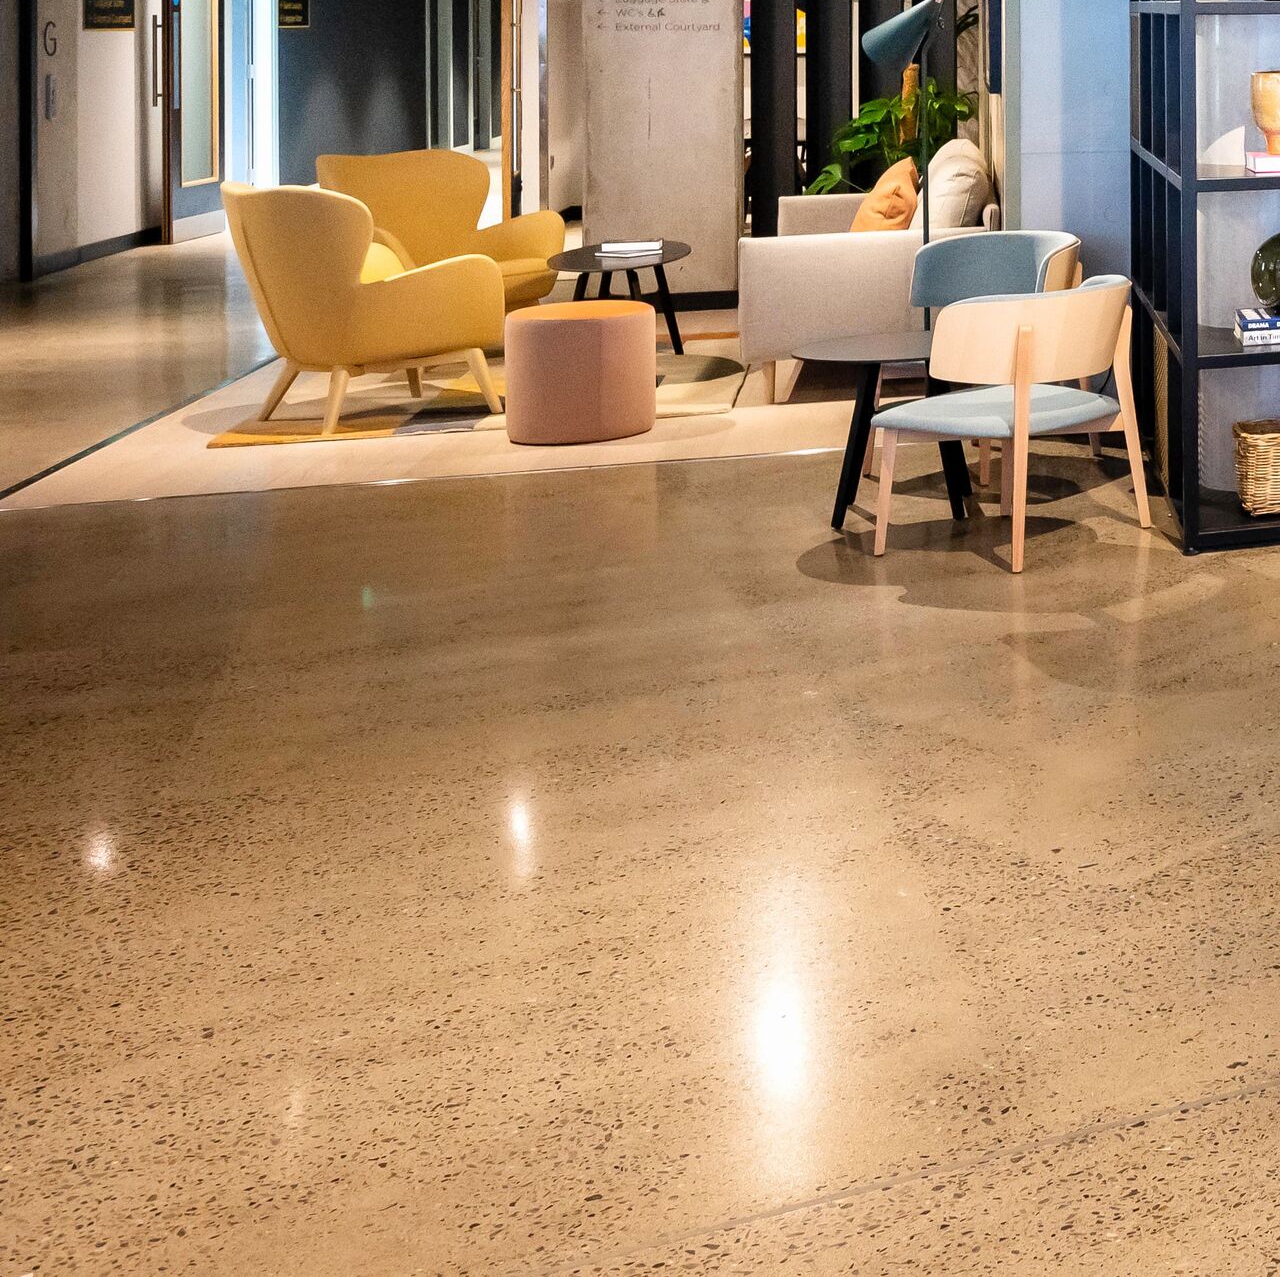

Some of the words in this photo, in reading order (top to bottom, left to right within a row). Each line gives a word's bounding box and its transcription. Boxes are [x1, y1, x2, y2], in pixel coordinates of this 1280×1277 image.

[615, 23, 661, 31] External
[664, 23, 721, 33] Courtyard
[44, 21, 57, 57] G
[1247, 321, 1270, 329] DRAMA
